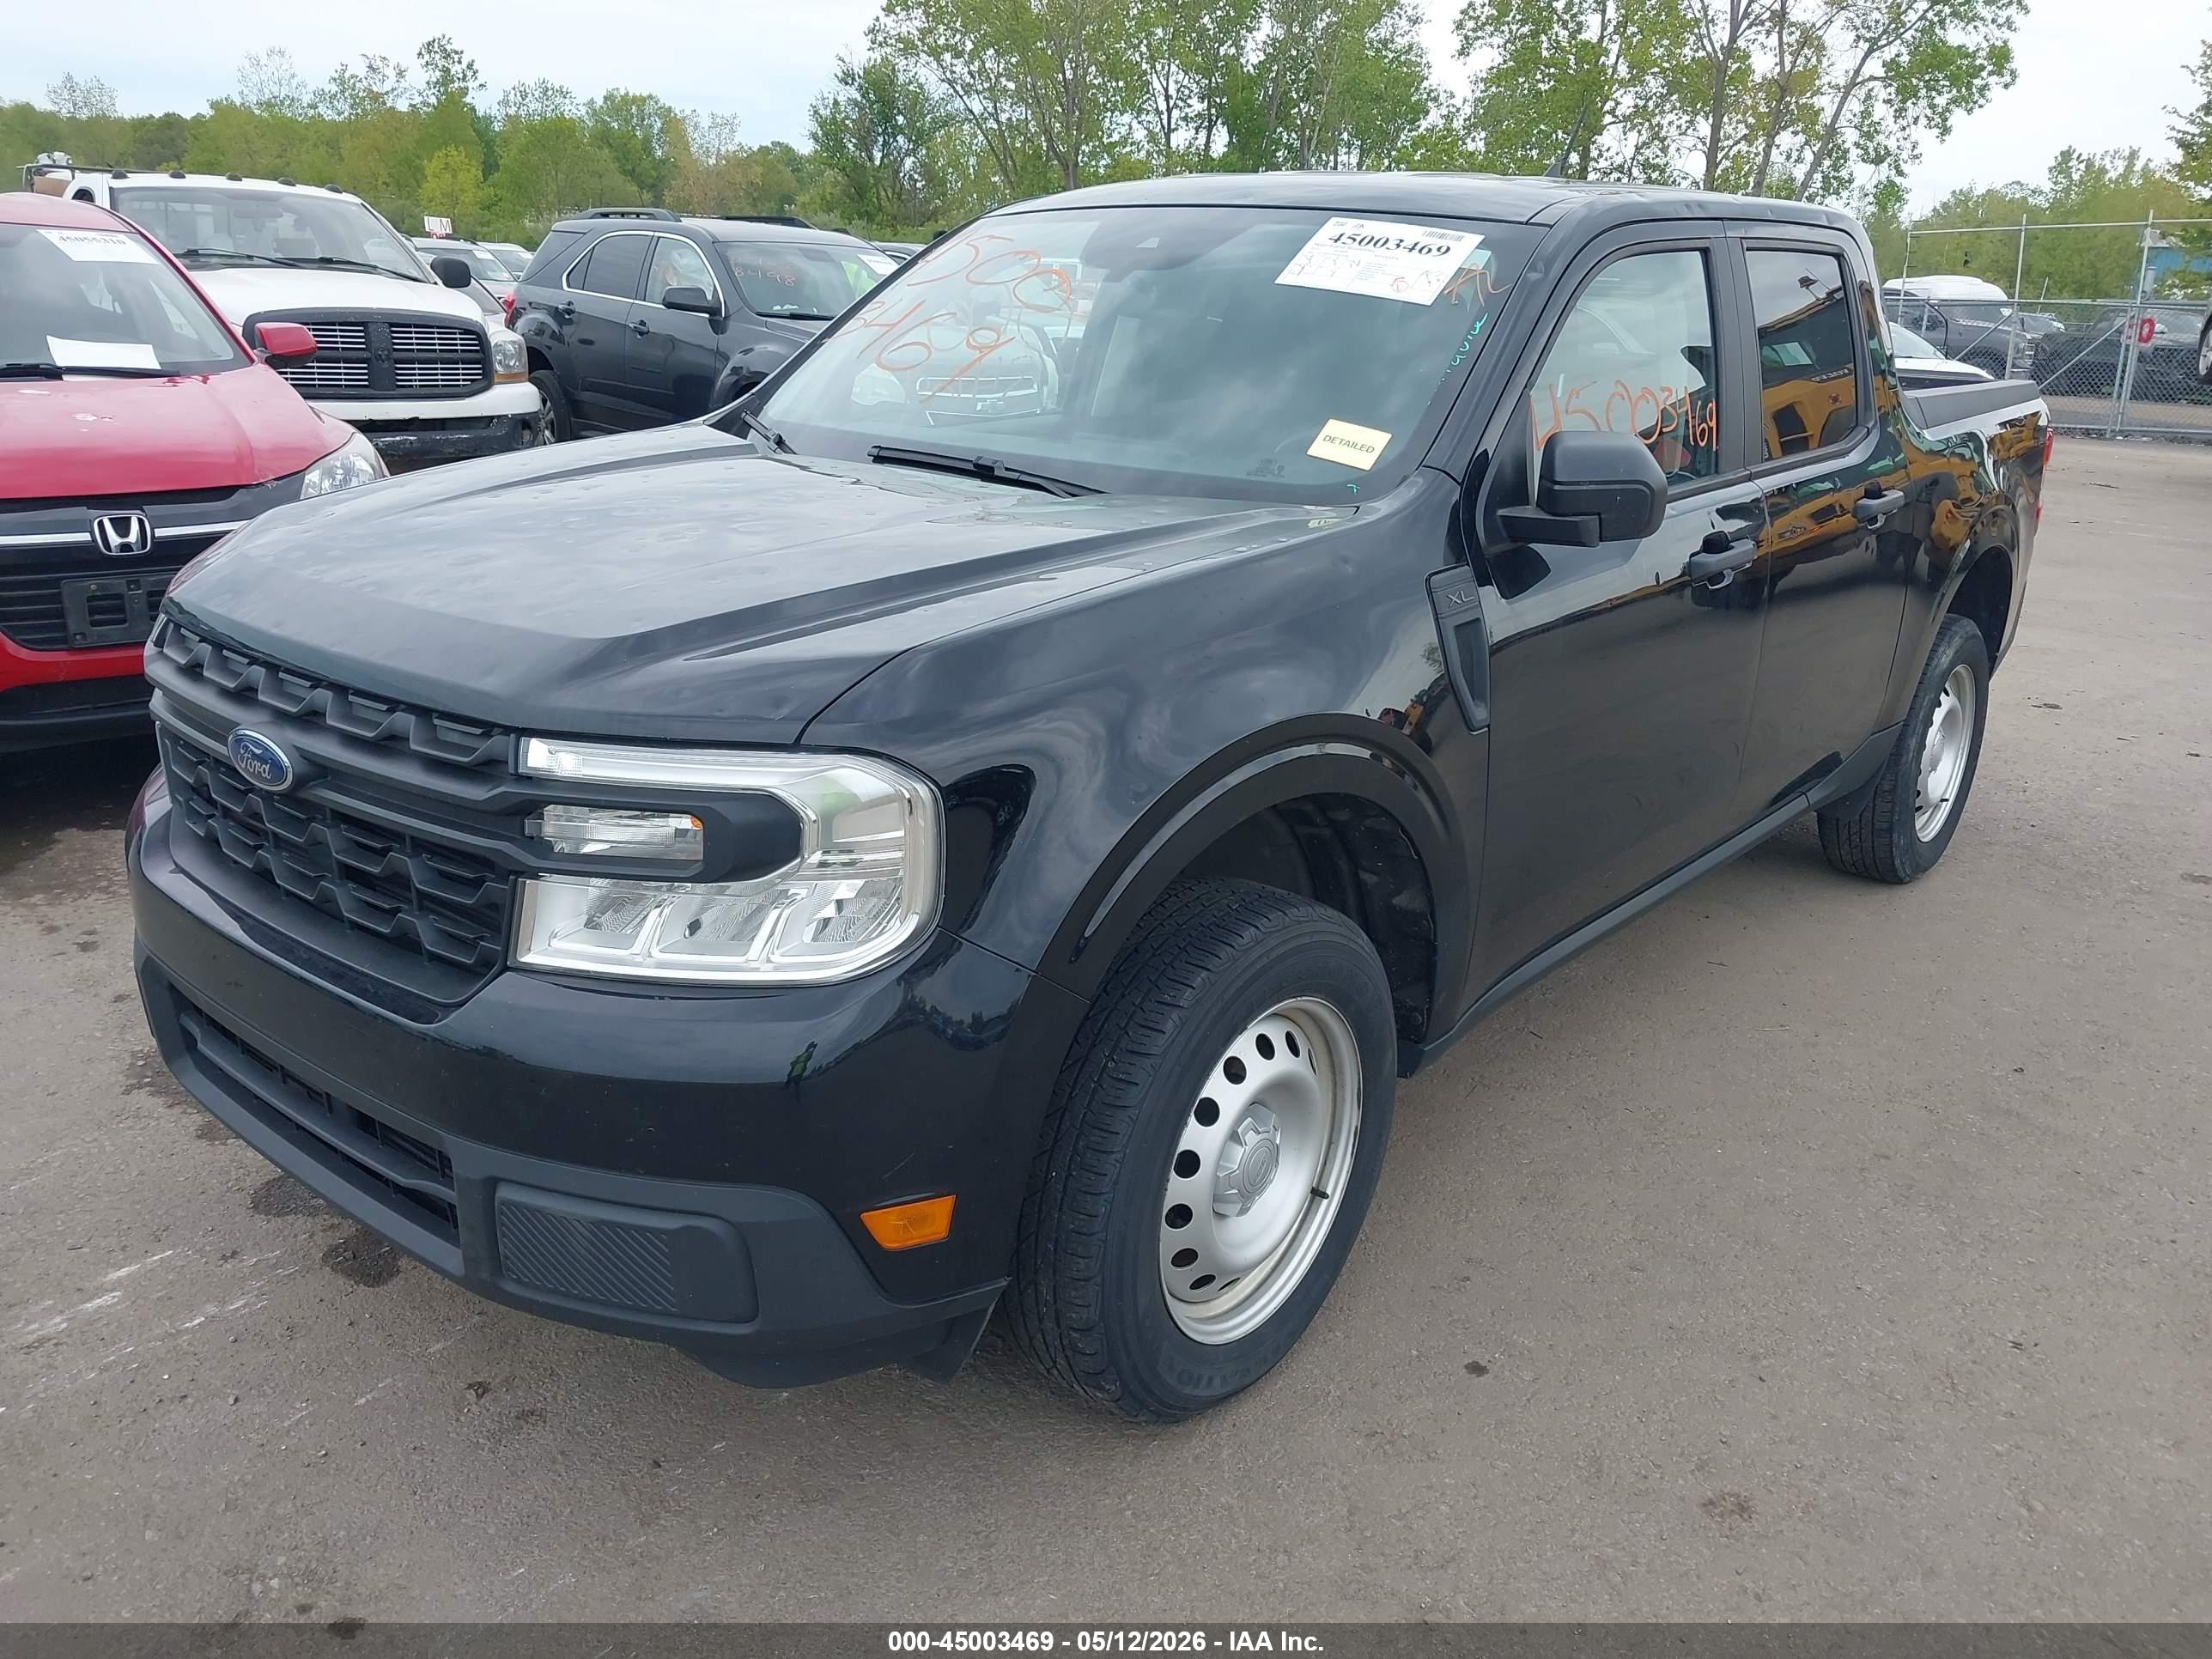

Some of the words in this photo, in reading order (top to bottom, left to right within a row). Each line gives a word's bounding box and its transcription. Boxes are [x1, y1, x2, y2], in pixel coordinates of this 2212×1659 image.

[1328, 232, 1451, 258] 45003469
[1322, 434, 1375, 454] DETAILED
[1446, 591, 1475, 606] XL
[238, 741, 274, 780] Ford
